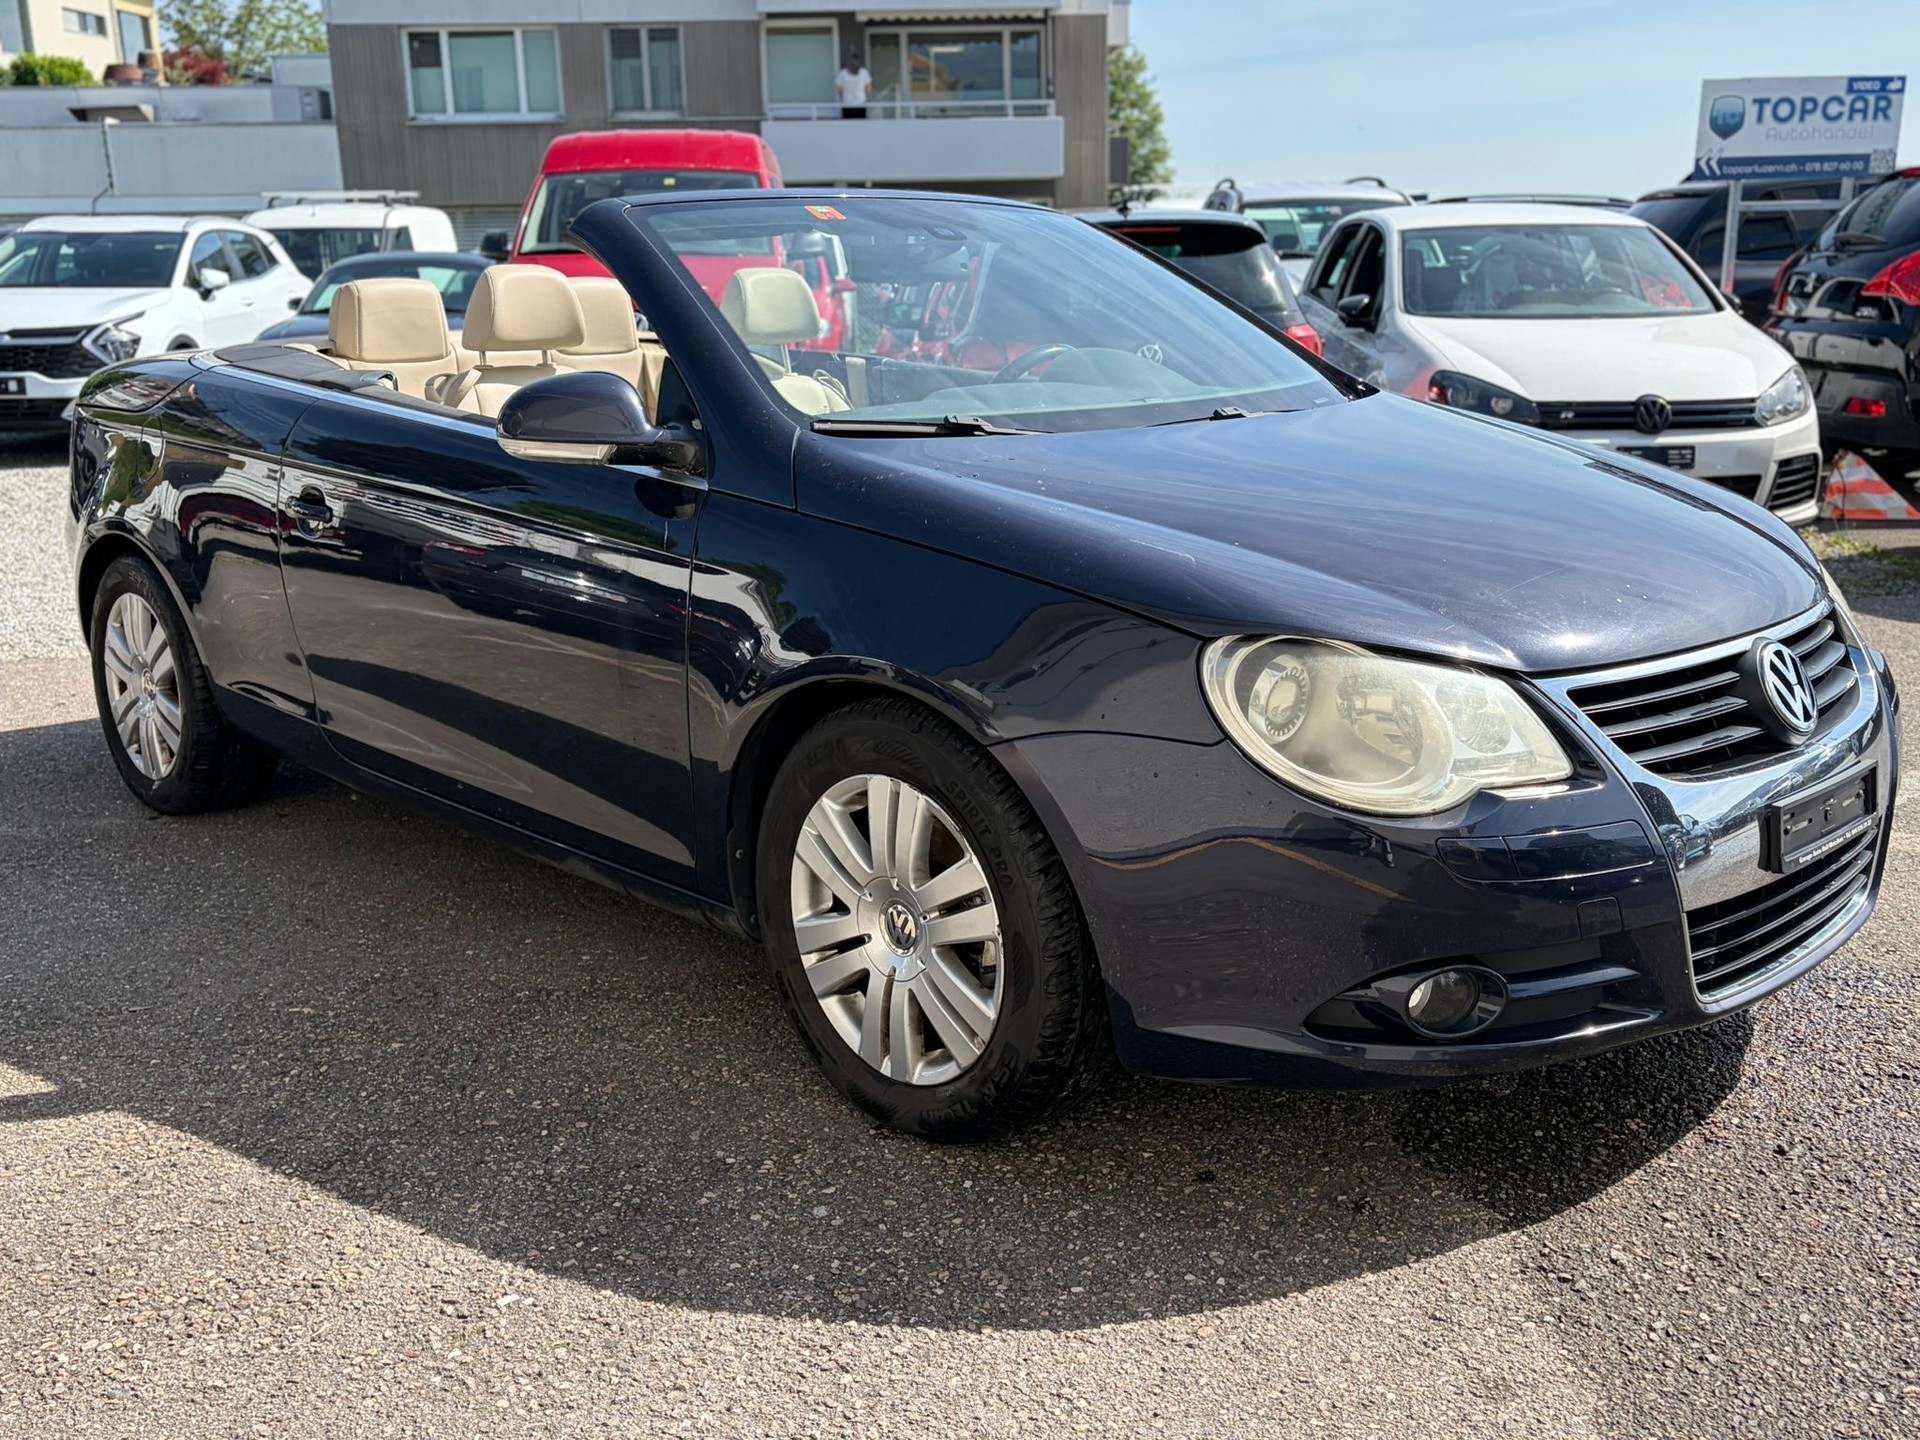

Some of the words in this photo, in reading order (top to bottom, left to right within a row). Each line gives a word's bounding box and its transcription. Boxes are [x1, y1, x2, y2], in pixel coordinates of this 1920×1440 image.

[1852, 80, 1881, 90] VIDEO
[1752, 95, 1892, 123] TOPCAR
[1765, 126, 1874, 141] Autohandel
[1852, 160, 1864, 170] 00
[946, 780, 992, 837] SPIRIT
[989, 846, 1014, 886] PRO
